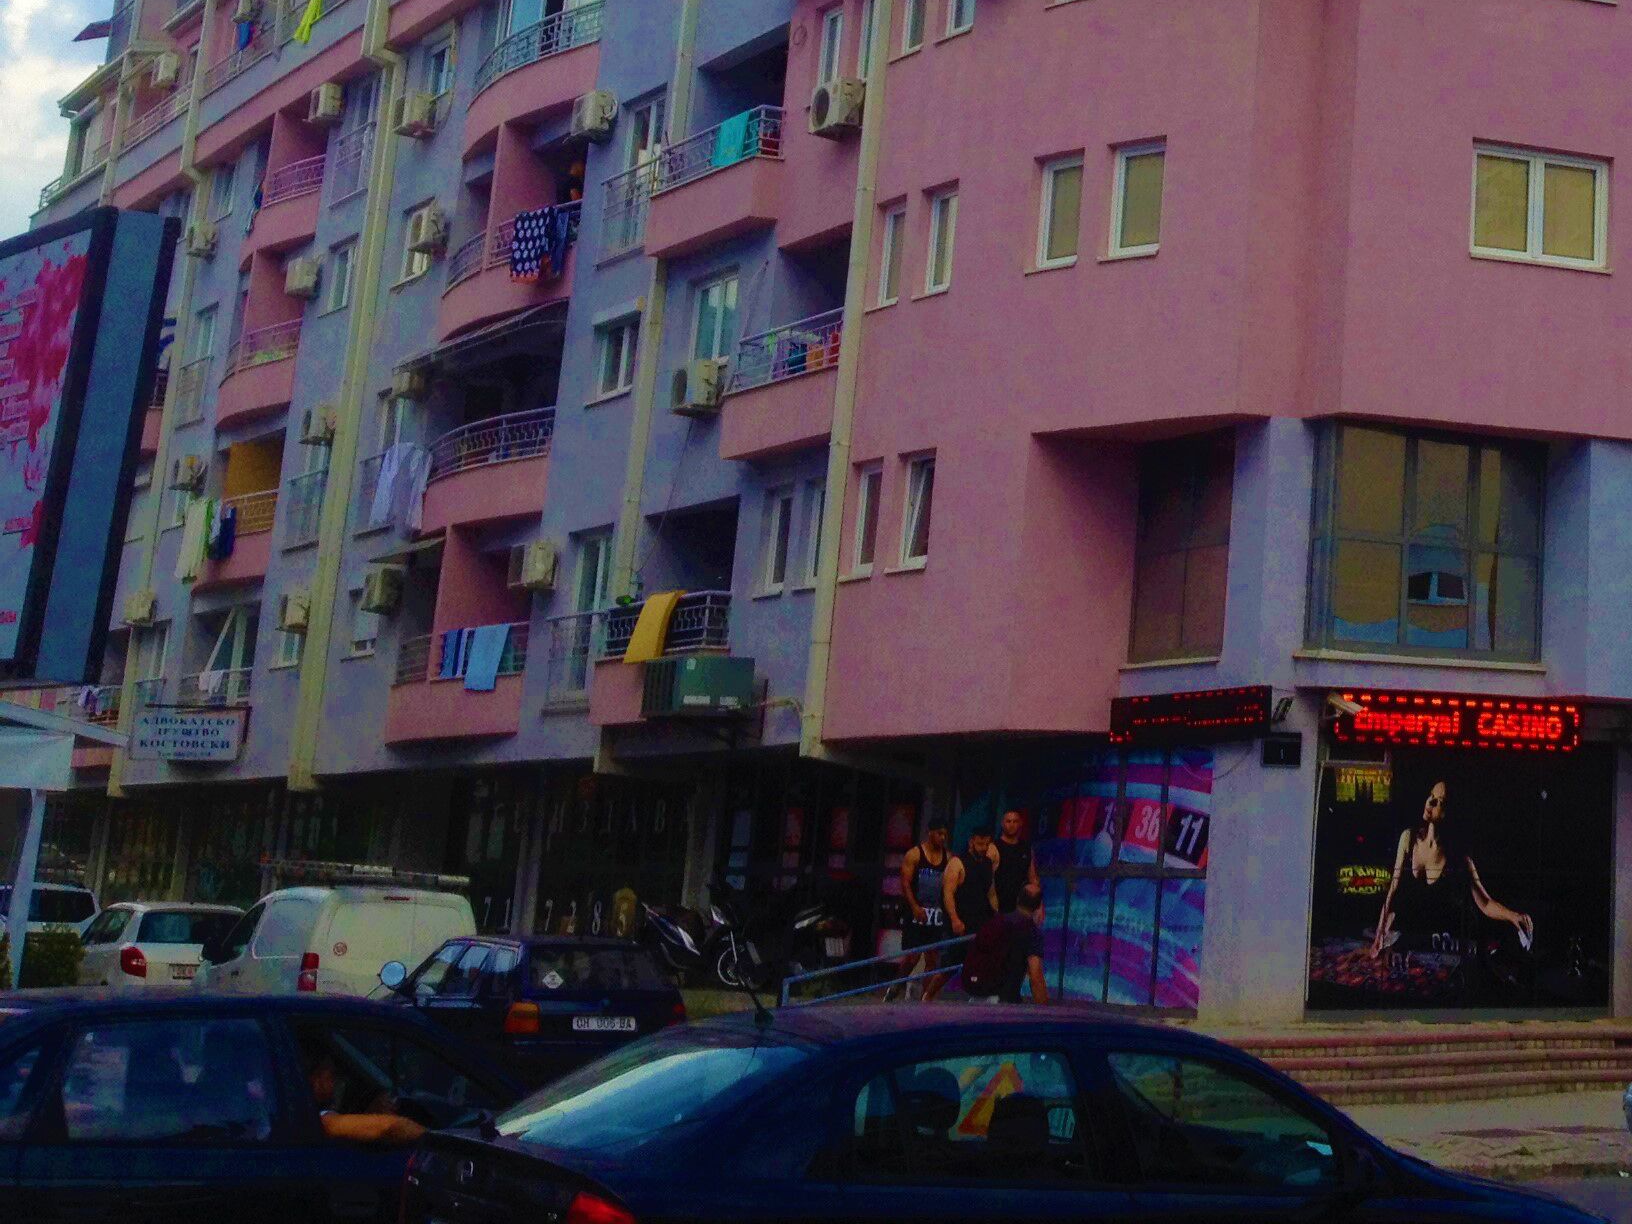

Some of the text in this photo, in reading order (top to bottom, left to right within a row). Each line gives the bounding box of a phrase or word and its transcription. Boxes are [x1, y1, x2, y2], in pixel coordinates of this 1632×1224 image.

[1354, 712, 1563, 739] Emperyal CASINO
[139, 739, 231, 749] КОСТОВСКИ
[1135, 805, 1160, 843] 36
[1175, 813, 1203, 855] 11
